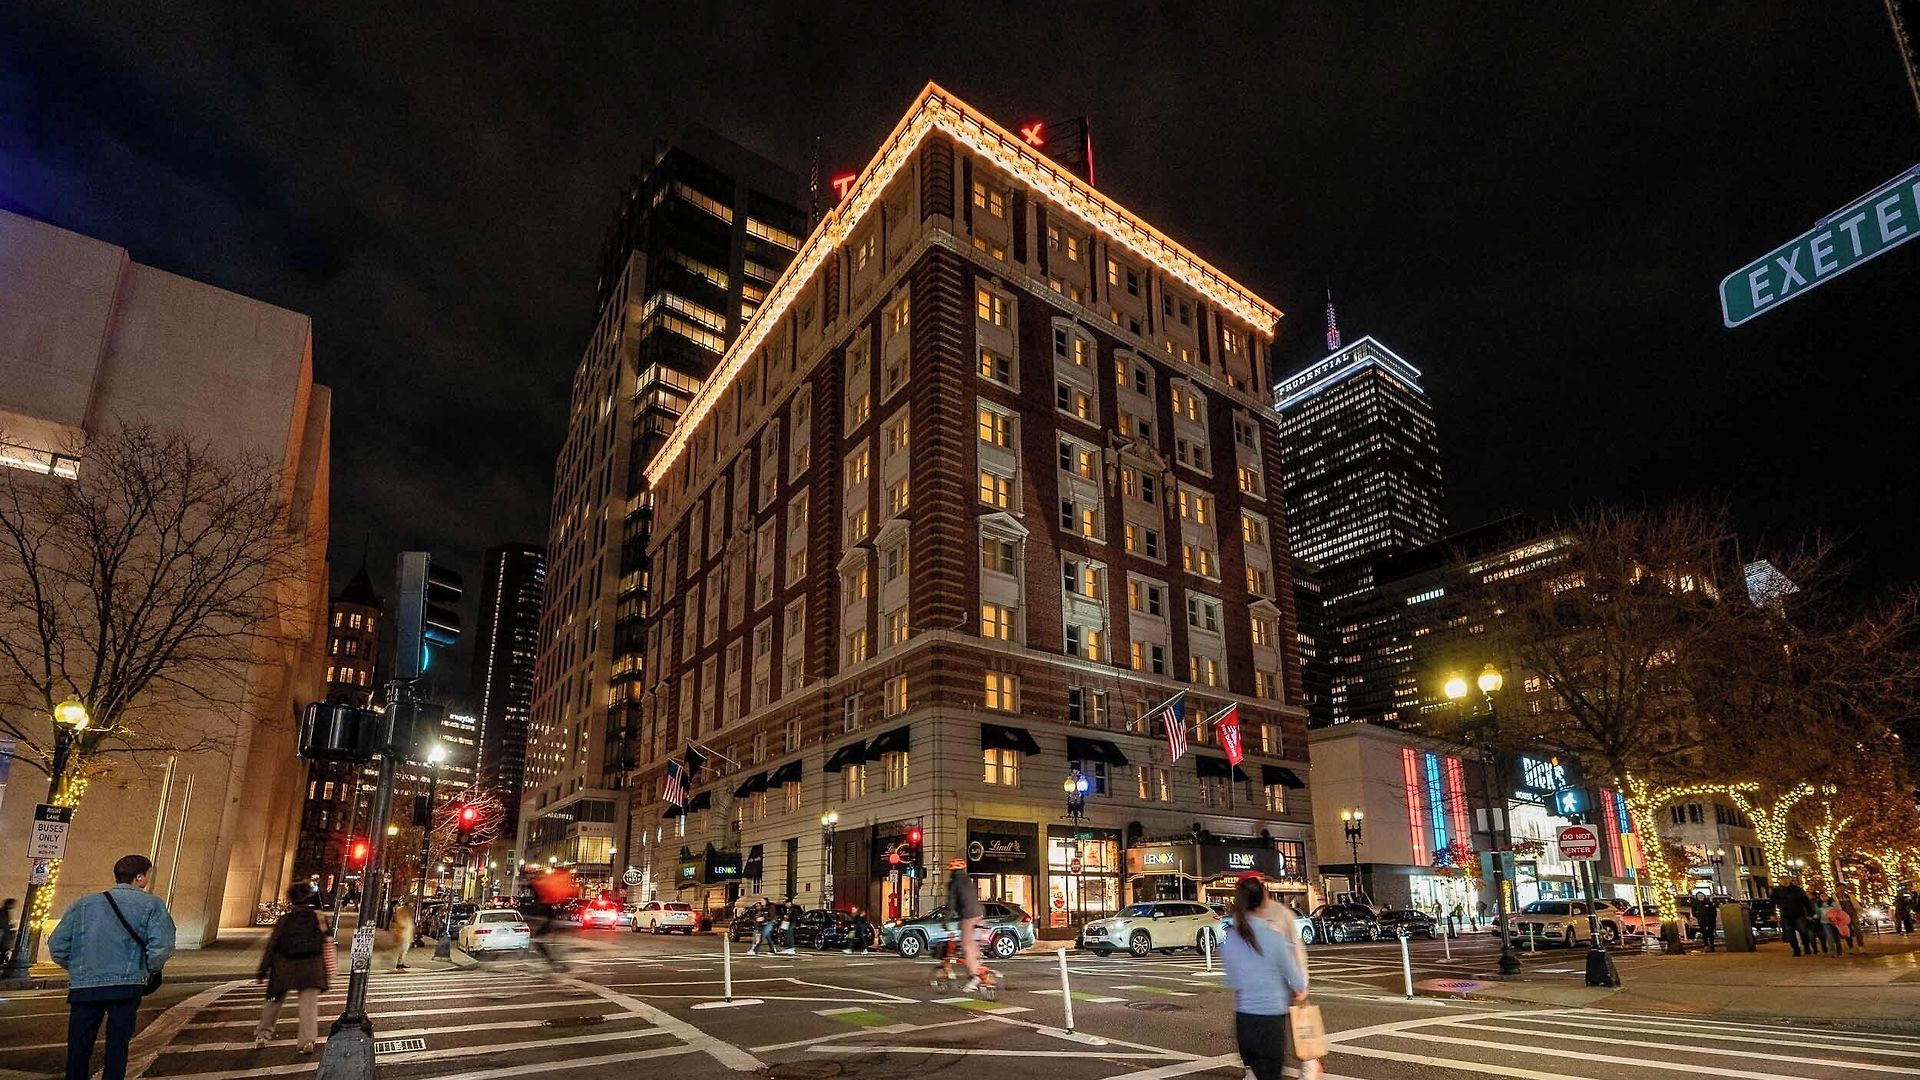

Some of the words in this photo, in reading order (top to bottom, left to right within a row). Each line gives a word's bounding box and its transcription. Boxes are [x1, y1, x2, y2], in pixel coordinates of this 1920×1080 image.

[1278, 353, 1350, 395] PRUDENTIAL
[1523, 757, 1566, 790] DICK'S
[38, 824, 64, 832] BUSES
[38, 834, 60, 842] ONLY
[988, 840, 1014, 852] Lindt
[1144, 853, 1174, 864] LENOX
[1229, 853, 1254, 865] LENOX
[714, 866, 736, 874] LENOX
